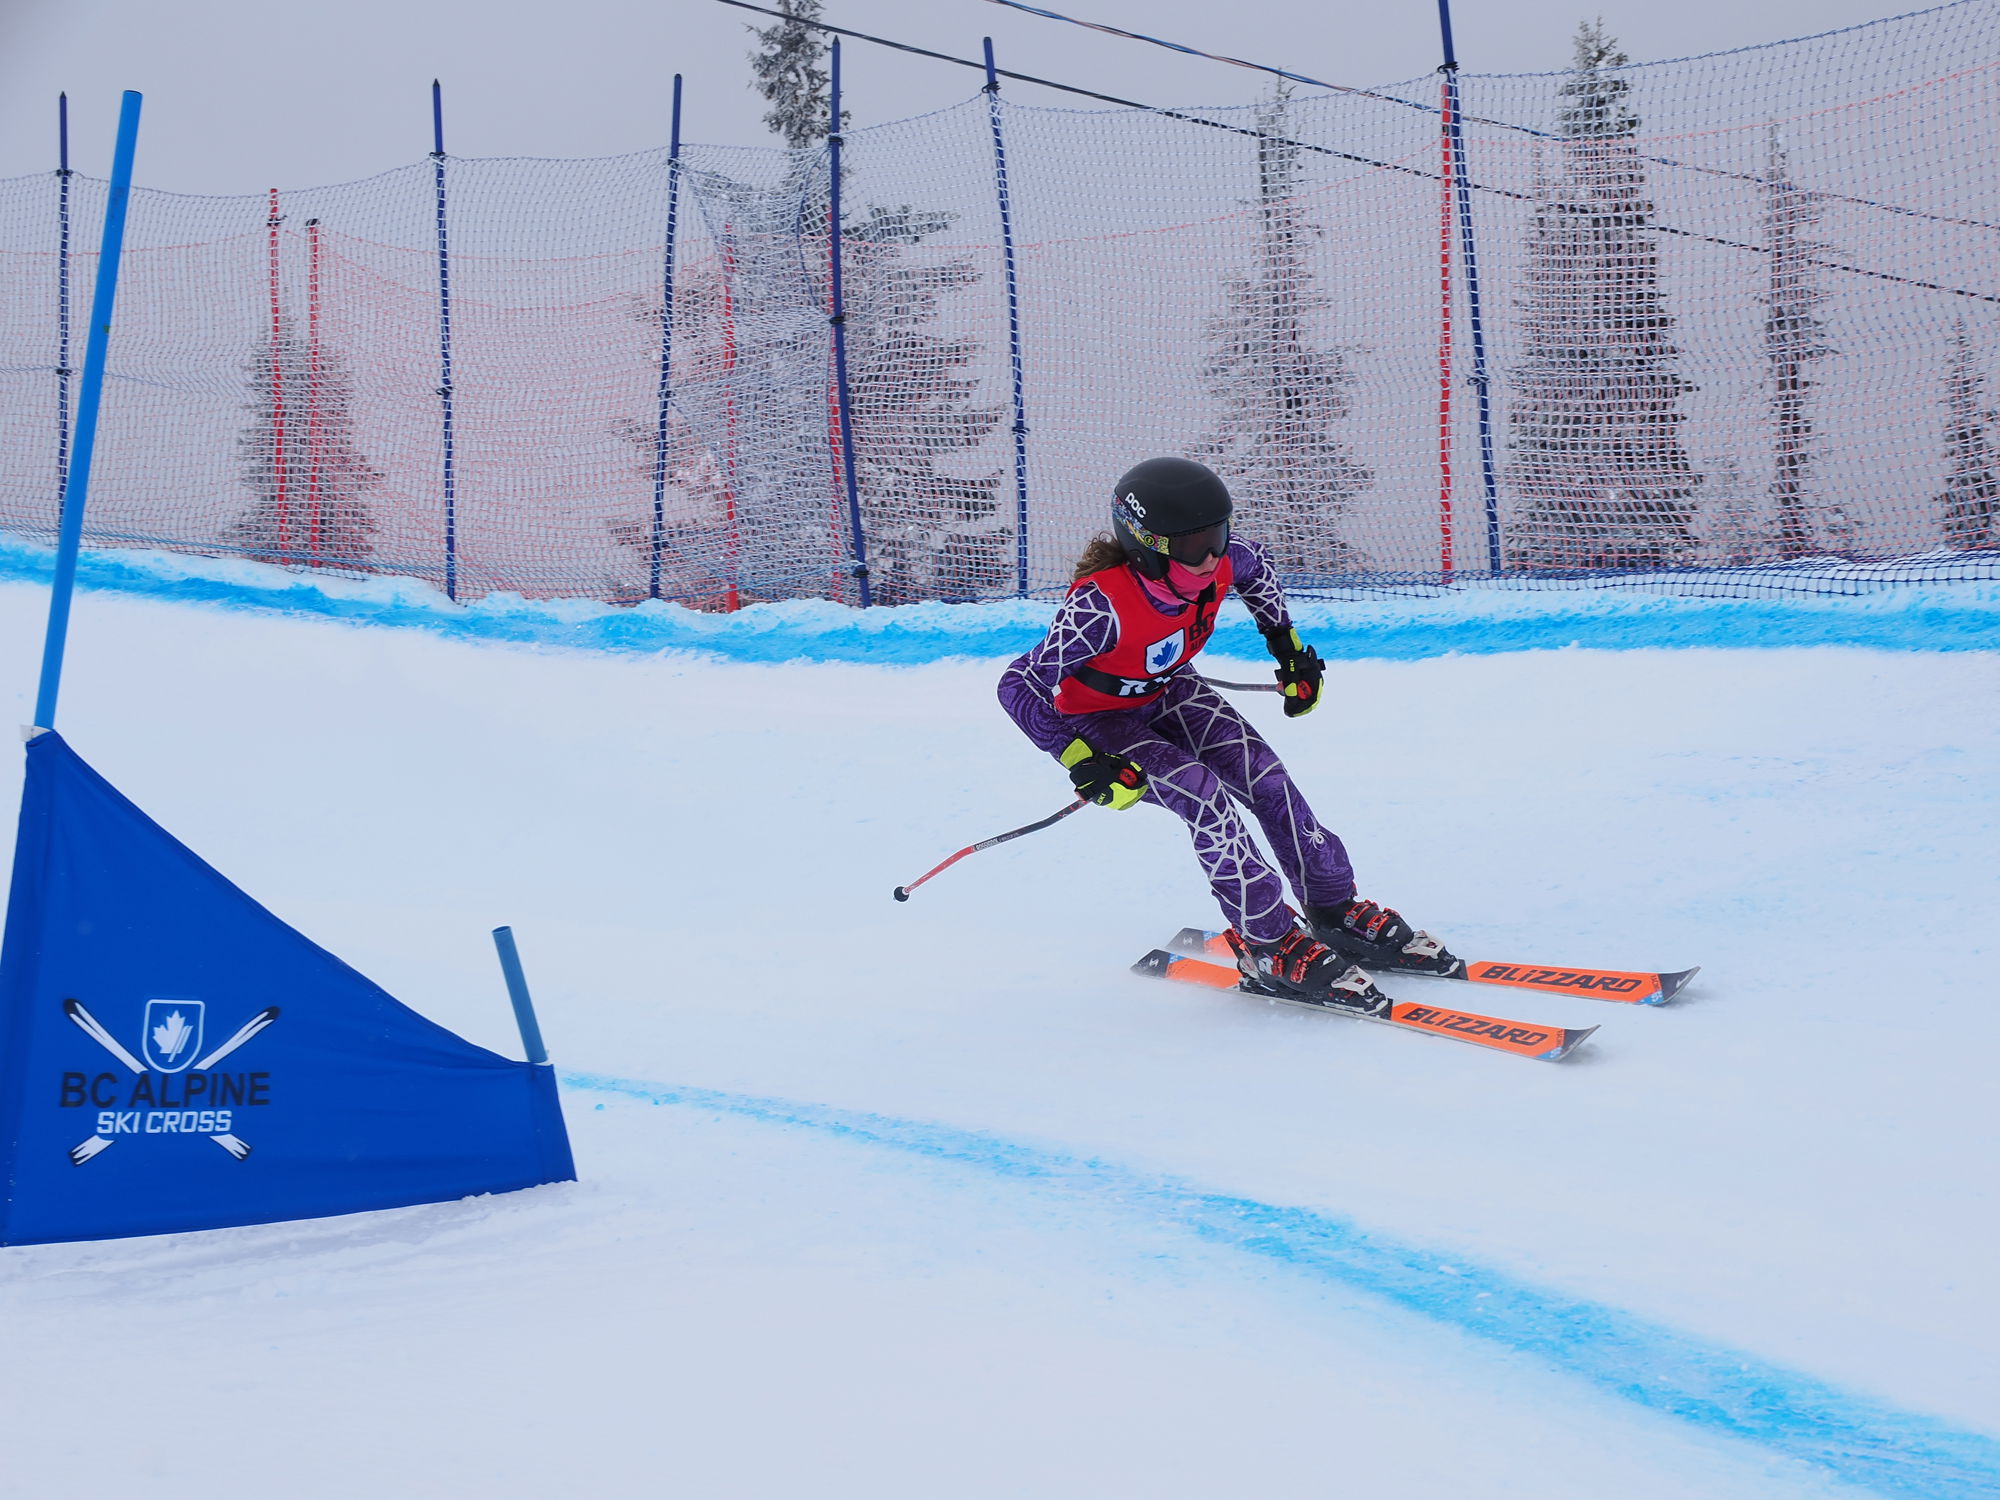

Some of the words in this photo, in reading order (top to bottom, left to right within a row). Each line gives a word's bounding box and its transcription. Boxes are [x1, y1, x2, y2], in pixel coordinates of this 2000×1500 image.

[1125, 492, 1147, 518] POC
[59, 1072, 118, 1108] BC
[128, 1072, 271, 1108] ALPINE
[97, 1111, 140, 1133] SKI
[145, 1110, 232, 1133] CROSS
